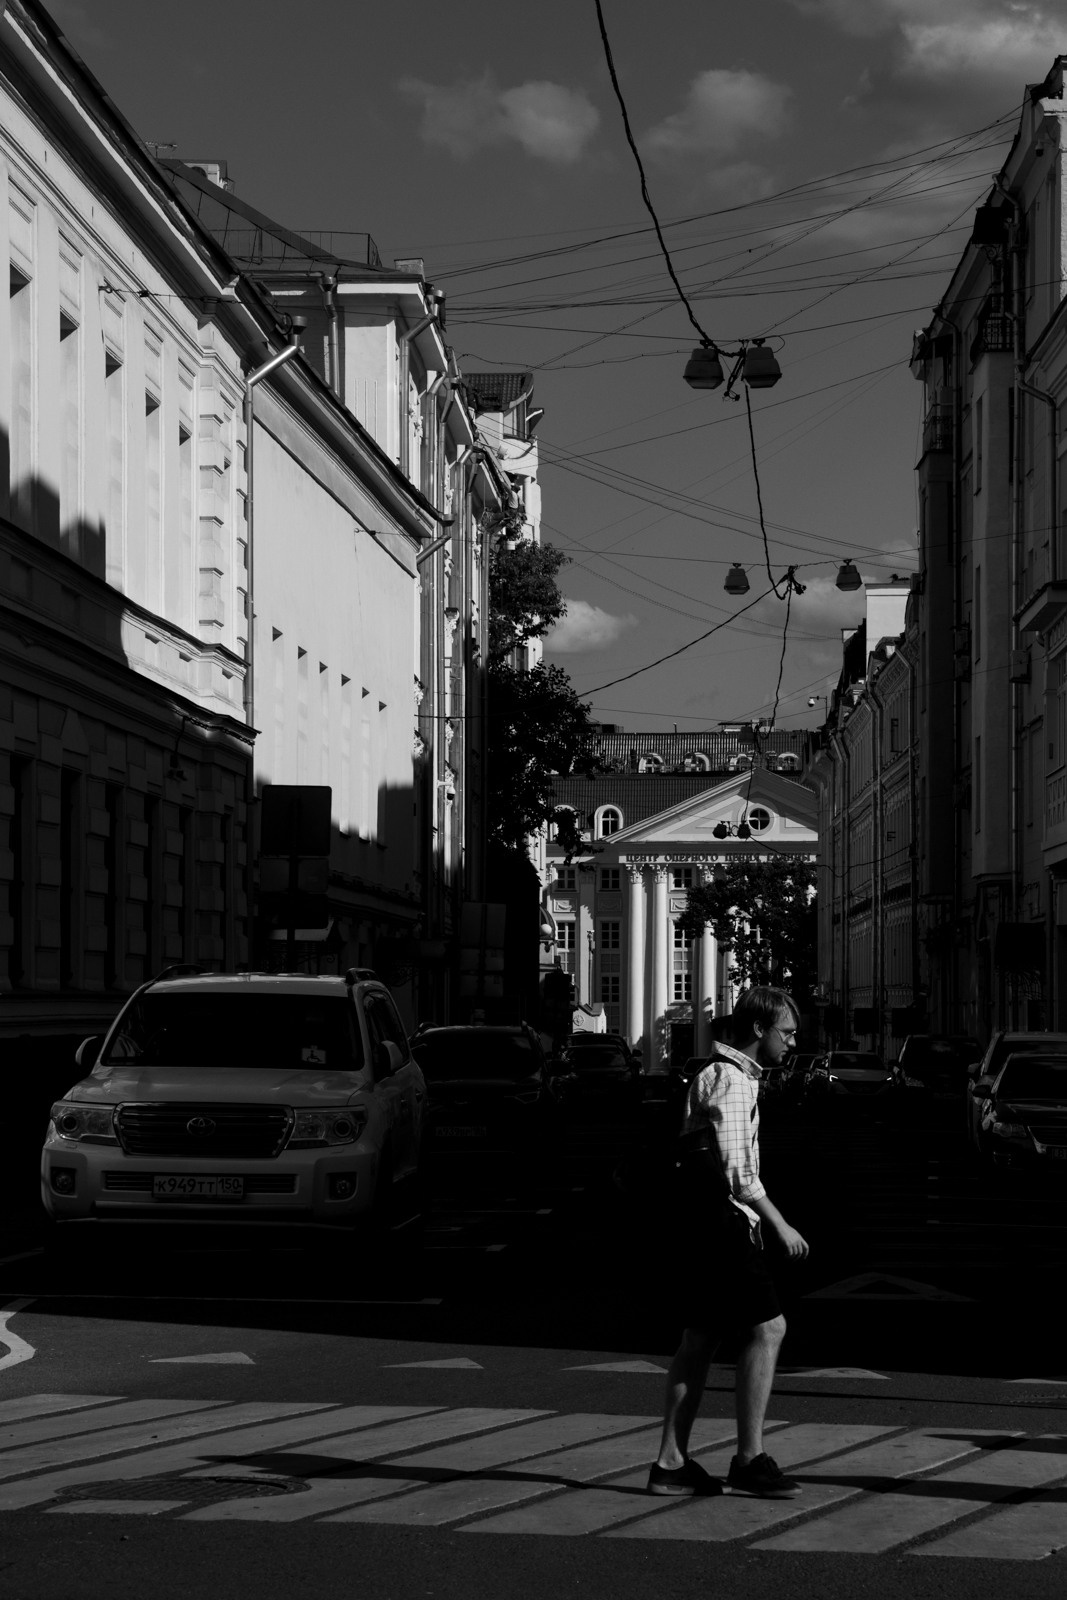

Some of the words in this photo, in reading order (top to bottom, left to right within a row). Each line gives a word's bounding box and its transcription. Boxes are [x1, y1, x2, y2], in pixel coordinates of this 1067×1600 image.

[626, 853, 660, 863] ЦЕНТР
[664, 853, 719, 863] ОПЕРНОГО
[725, 852, 761, 862] ПЕНИЯ
[158, 1177, 215, 1193] К949ТТ
[218, 1178, 240, 1190] 150
